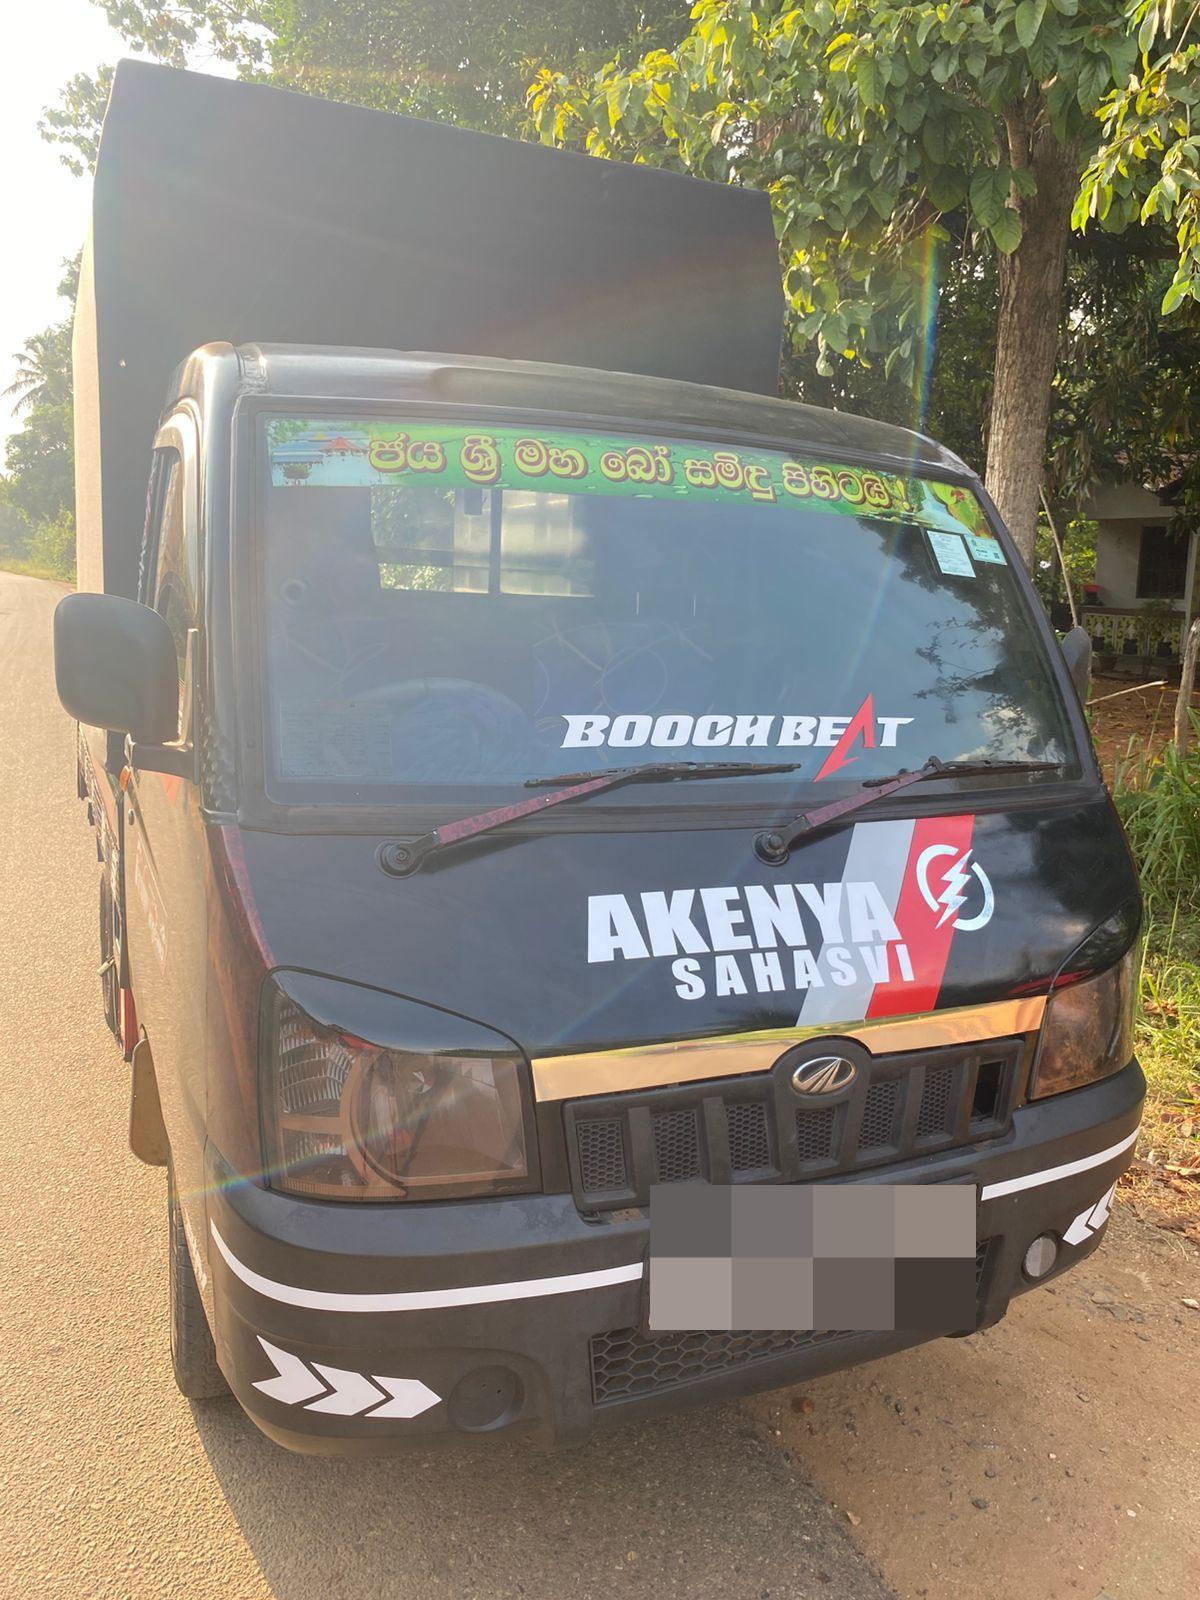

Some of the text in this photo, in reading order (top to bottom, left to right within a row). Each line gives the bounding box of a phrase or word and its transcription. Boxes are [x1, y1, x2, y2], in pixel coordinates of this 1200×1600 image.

[368, 432, 447, 473] ජය
[513, 440, 587, 477] මහ
[600, 447, 676, 484] බෝ
[777, 692, 915, 783] BEAT
[587, 881, 902, 964] AKENYA
[672, 944, 916, 1000] SAHASVI
